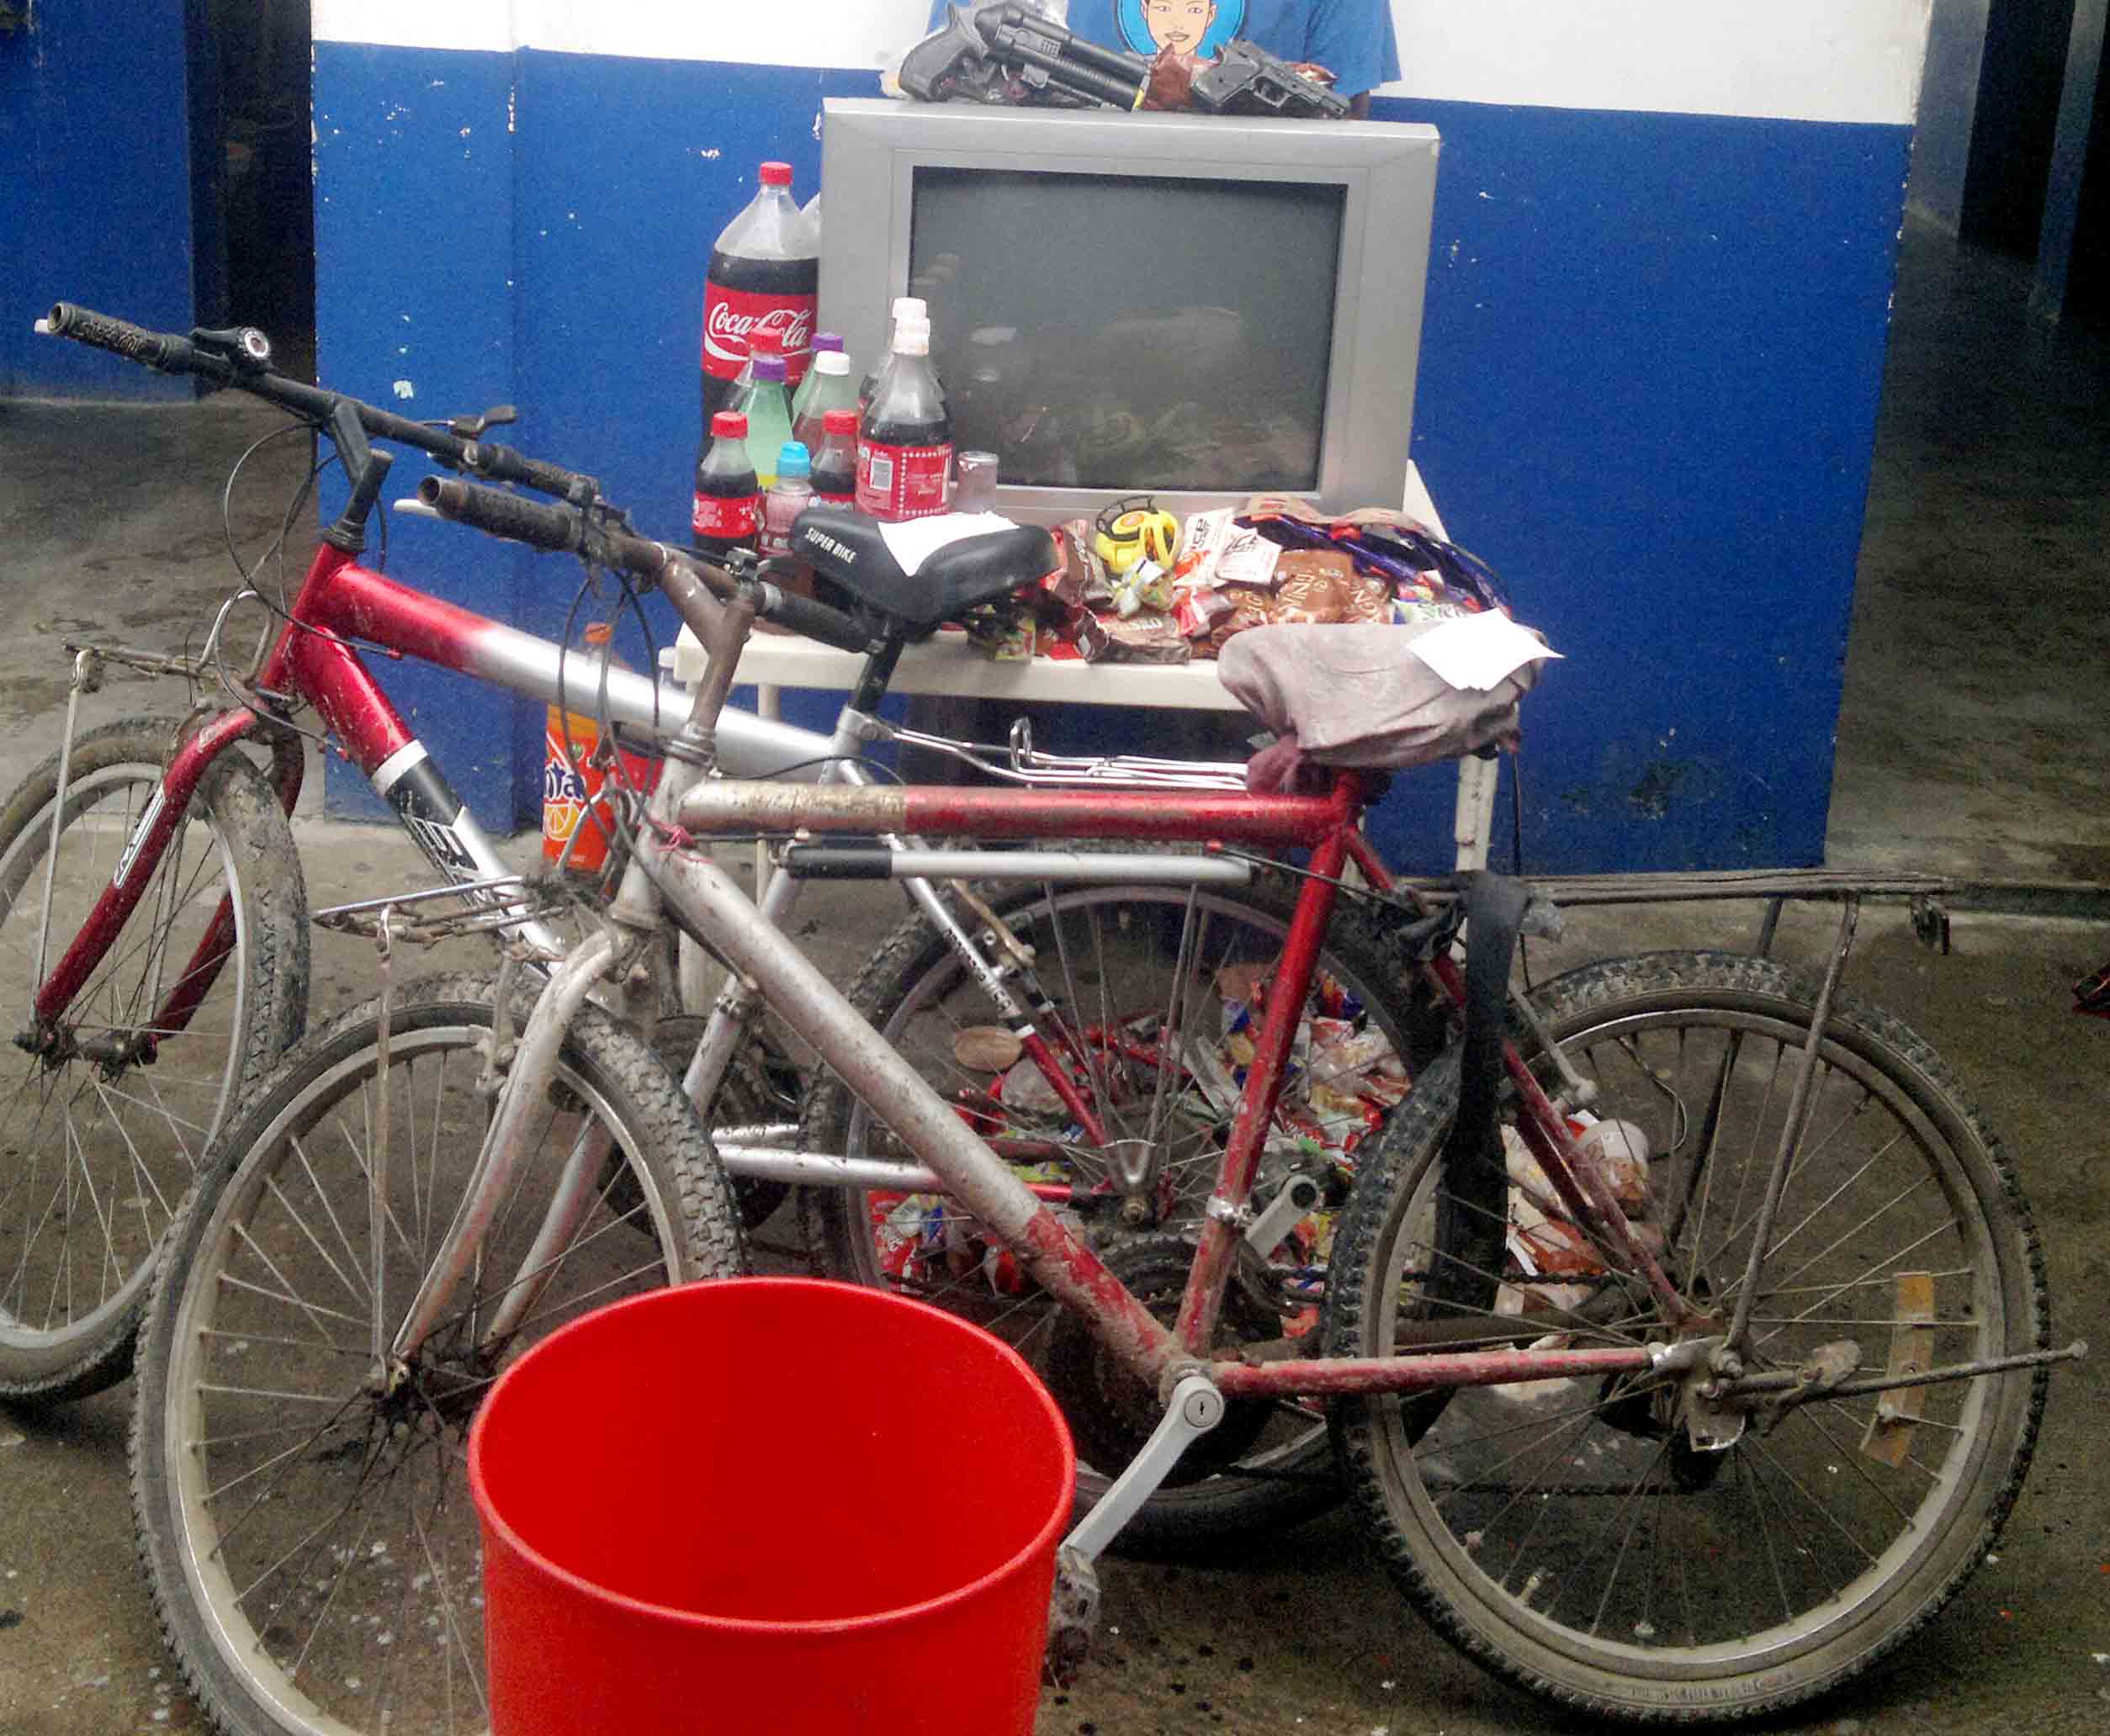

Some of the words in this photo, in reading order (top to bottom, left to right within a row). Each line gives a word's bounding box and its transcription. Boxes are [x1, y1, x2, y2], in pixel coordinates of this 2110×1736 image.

[708, 302, 813, 348] Coca-Cla
[804, 527, 835, 552] SUPER
[832, 542, 856, 564] BIKE
